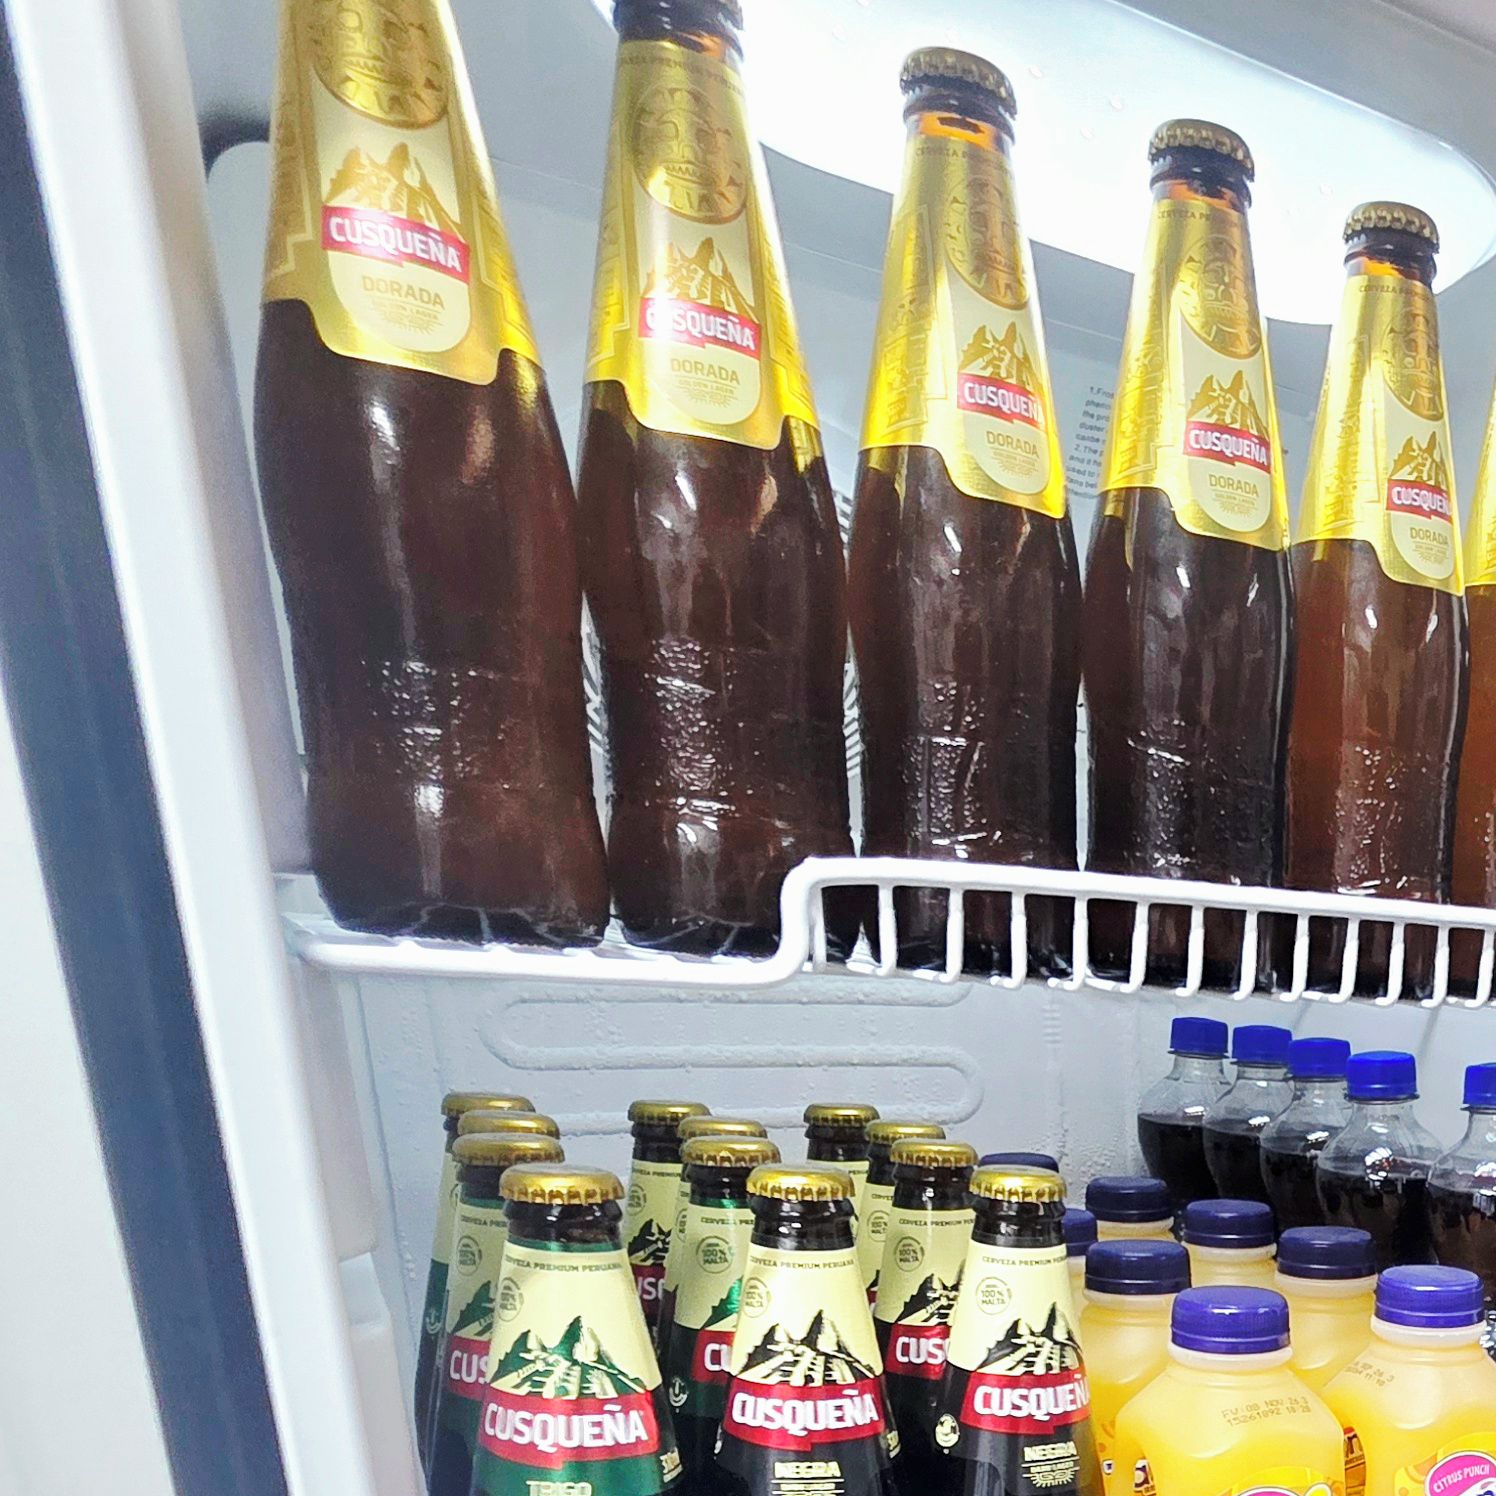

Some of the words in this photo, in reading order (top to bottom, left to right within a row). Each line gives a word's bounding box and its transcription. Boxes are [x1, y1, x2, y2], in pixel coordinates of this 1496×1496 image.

[328, 215, 462, 274] CUSQUEÑA
[362, 275, 445, 311] DORADA
[670, 357, 741, 386] DORADA
[986, 430, 1040, 459] DORADA
[1189, 430, 1268, 467] CUSQUEÑA
[1208, 473, 1260, 498] DORADA
[1410, 526, 1449, 545] DORADA
[899, 1217, 928, 1227] CERVEZA
[930, 1219, 962, 1227] PREMIUM
[533, 1261, 579, 1273] PREMIUM
[703, 1255, 728, 1265] MALTA
[780, 1259, 821, 1270] PREMIUM
[898, 1254, 919, 1264] MALTA
[982, 1255, 1017, 1266] CERVEZA
[1018, 1258, 1052, 1267] PREMIUM
[981, 1297, 1007, 1307] MALTA
[731, 1388, 880, 1437] CUSQUEÑA
[484, 1403, 649, 1454] CUSQUEÑA
[1432, 1471, 1463, 1494] CITRUS
[1463, 1463, 1491, 1480] PUNCH
